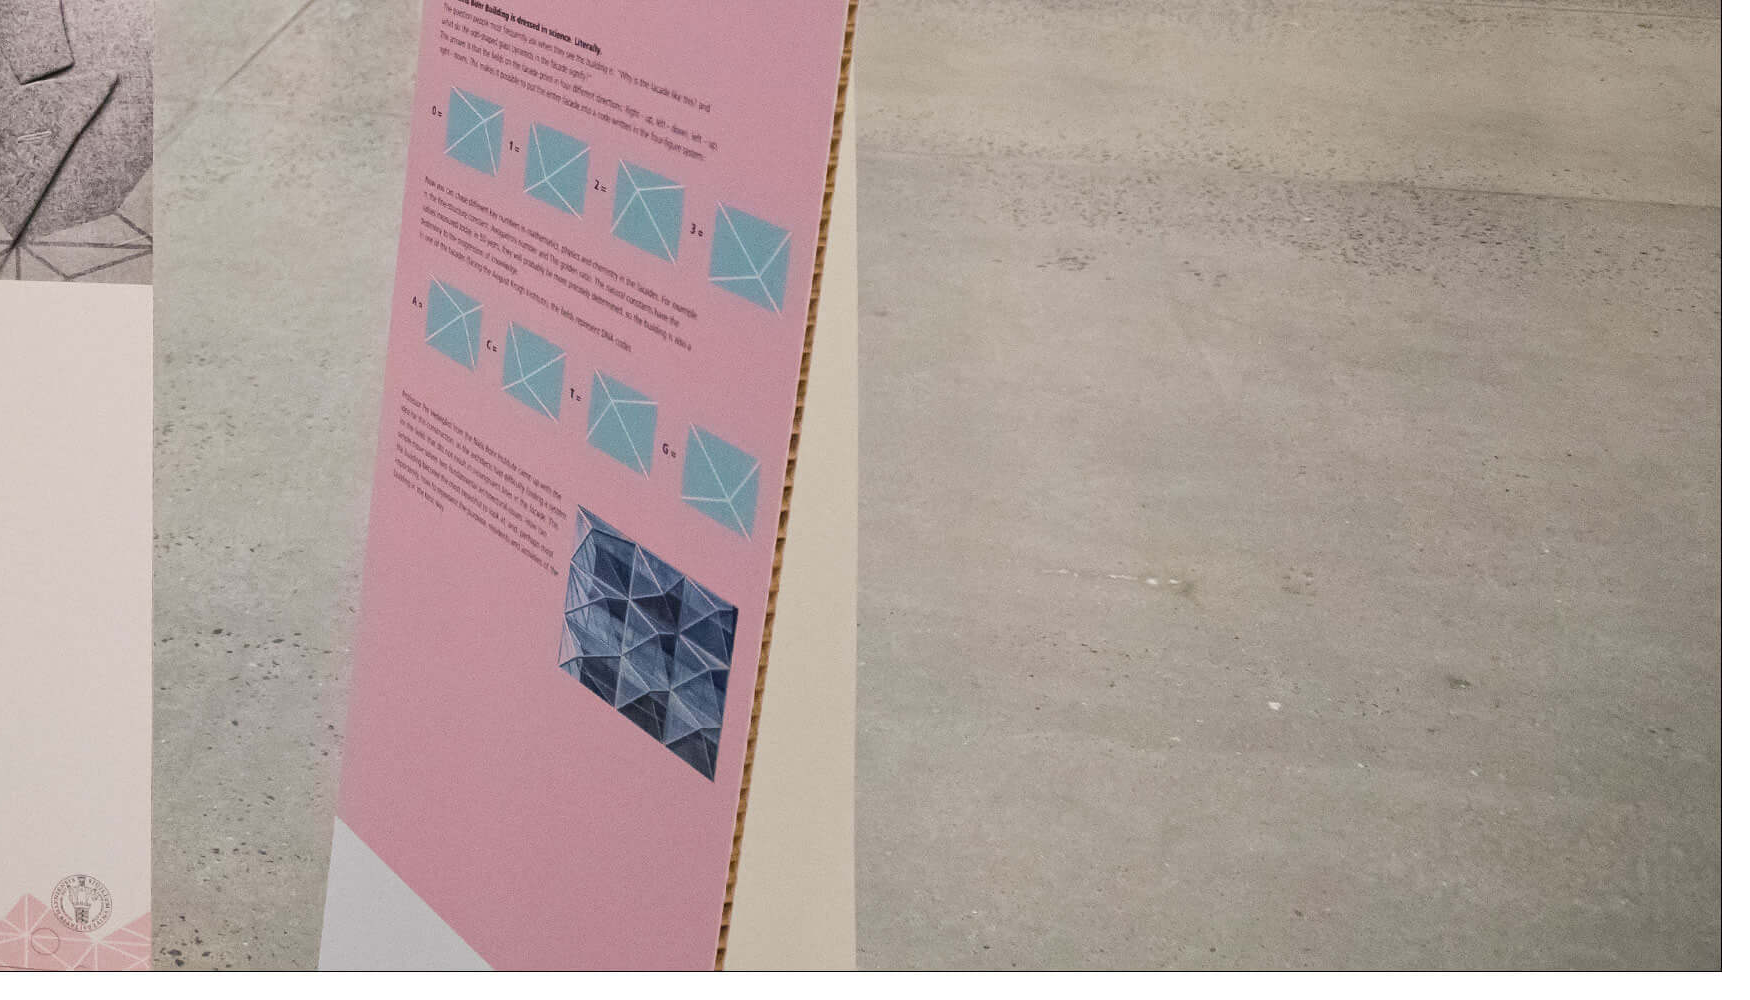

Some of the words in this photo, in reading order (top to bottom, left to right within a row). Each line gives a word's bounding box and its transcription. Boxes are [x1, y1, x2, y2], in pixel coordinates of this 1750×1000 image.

[484, 2, 509, 21] Building
[510, 12, 516, 22] is
[516, 14, 540, 31] dressed
[540, 23, 547, 33] in
[573, 36, 602, 56] Literally.
